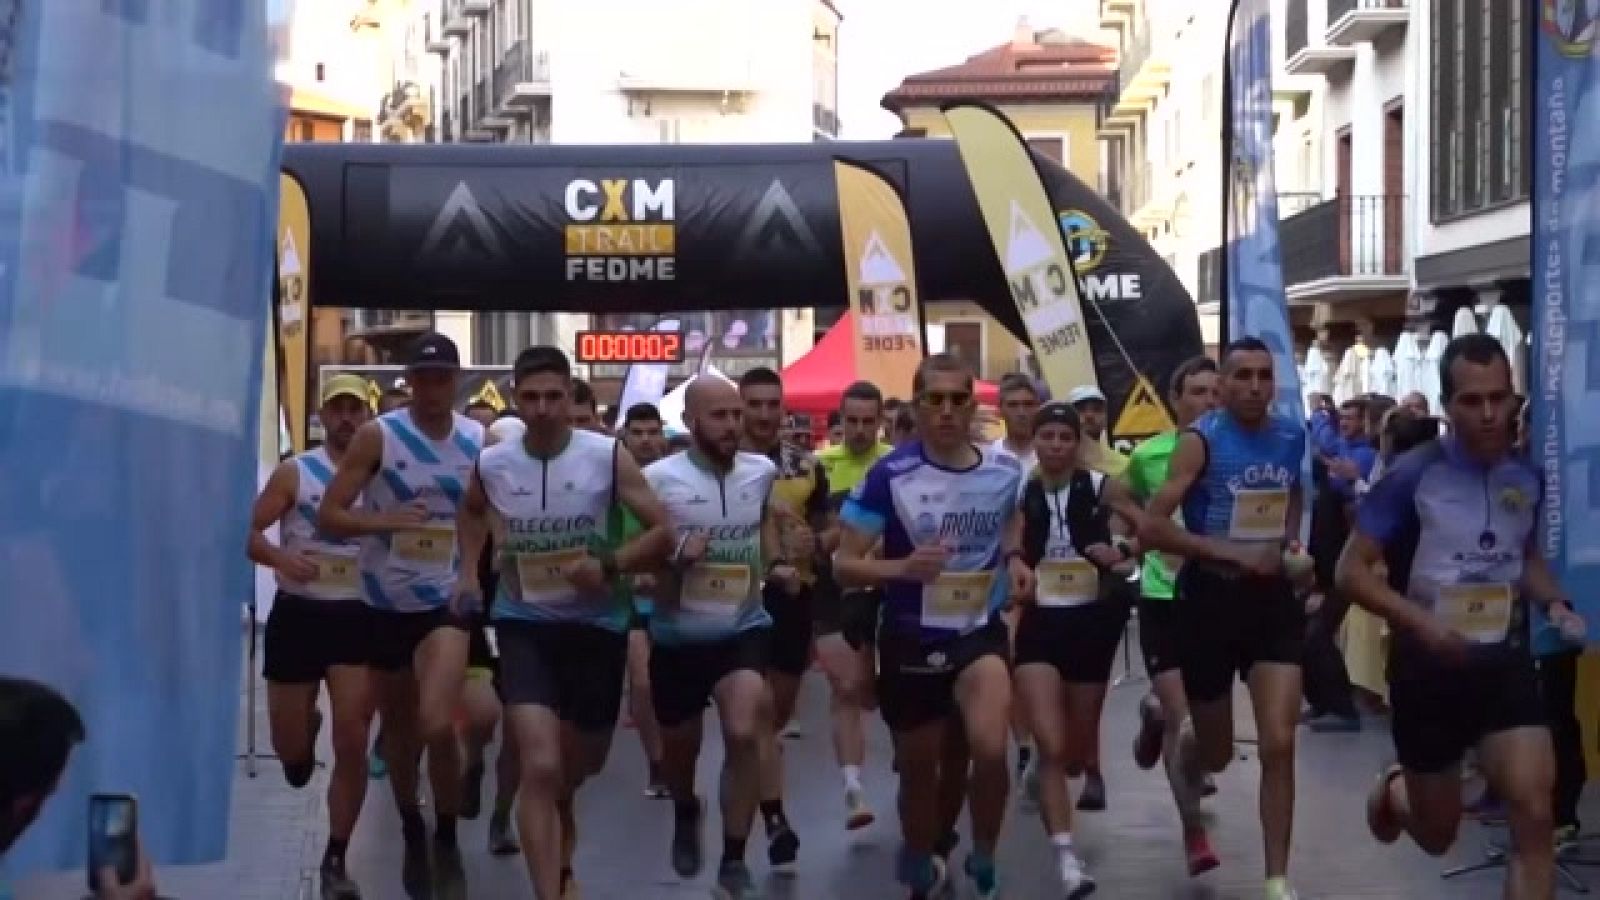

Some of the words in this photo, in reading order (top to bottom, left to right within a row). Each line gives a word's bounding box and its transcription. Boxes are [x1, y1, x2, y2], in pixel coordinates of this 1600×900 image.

[565, 179, 675, 221] CXM
[574, 227, 664, 251] TRAIL
[567, 257, 675, 280] FEDME
[1080, 274, 1141, 299] ME
